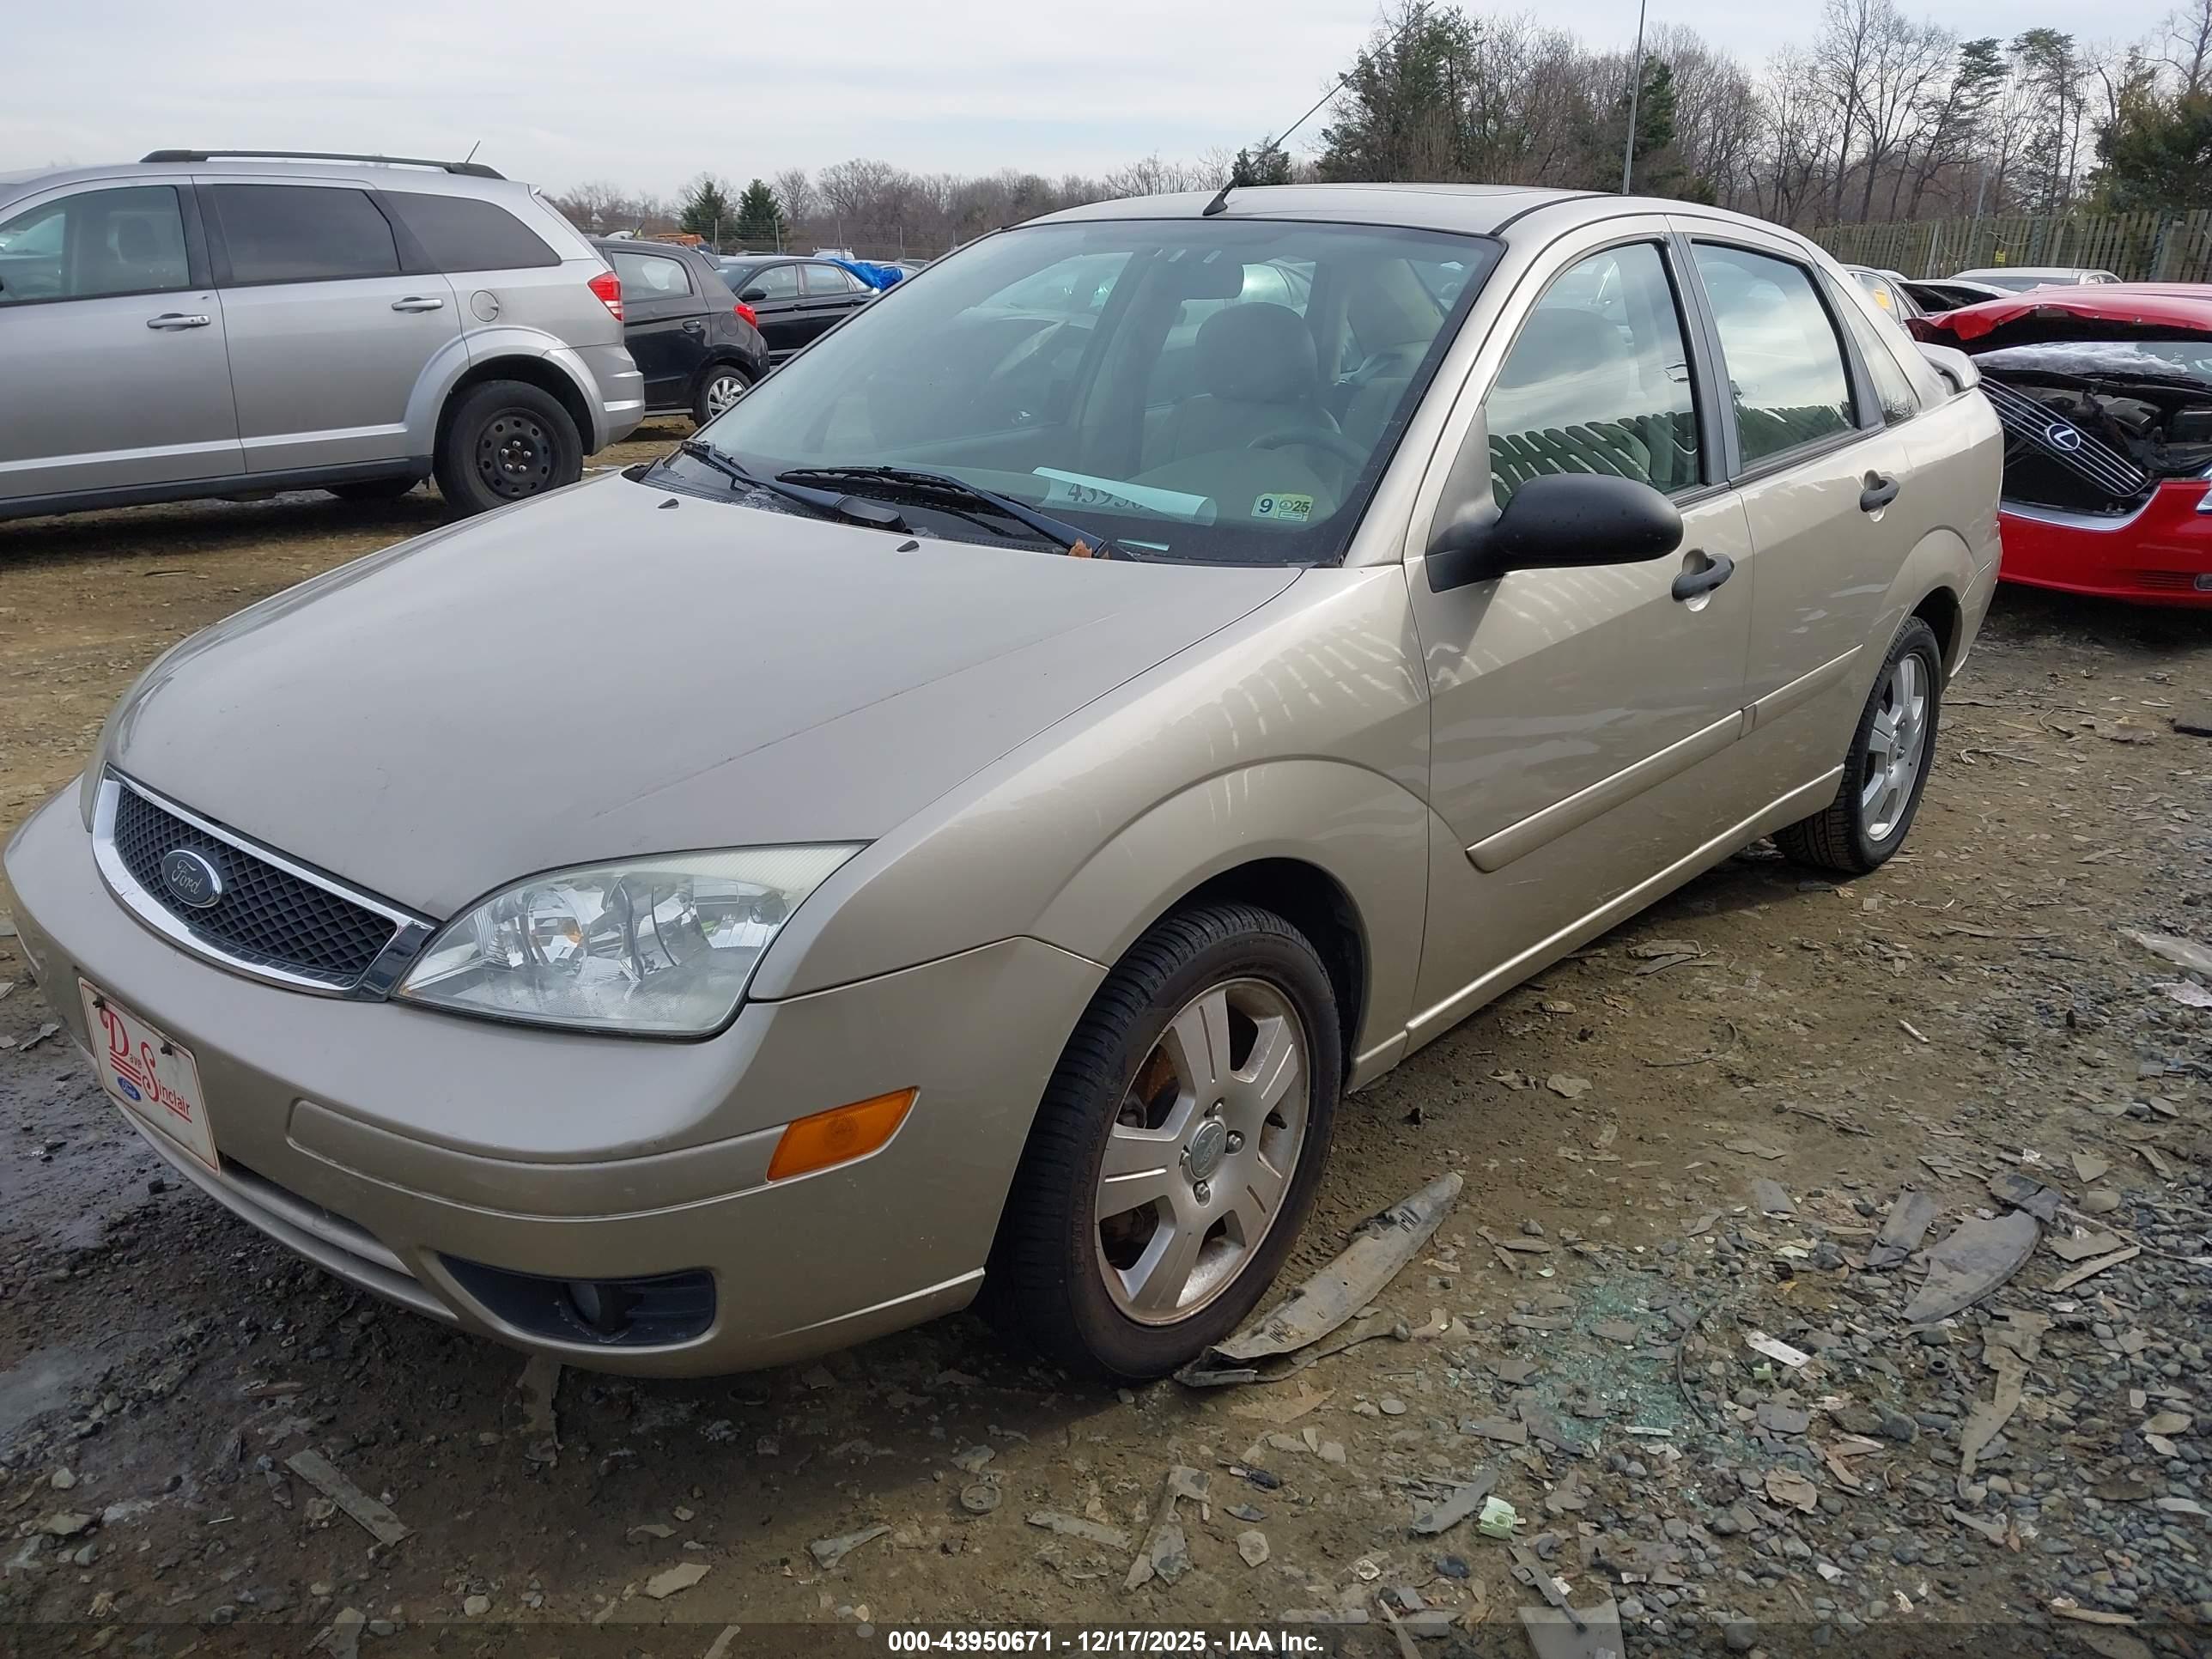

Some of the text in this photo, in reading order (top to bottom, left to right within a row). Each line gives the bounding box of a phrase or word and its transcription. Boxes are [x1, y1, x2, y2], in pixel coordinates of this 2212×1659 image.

[1259, 498, 1311, 514] 9 25
[171, 860, 204, 895] Ford
[100, 1007, 191, 1115] Dave Sinclair
